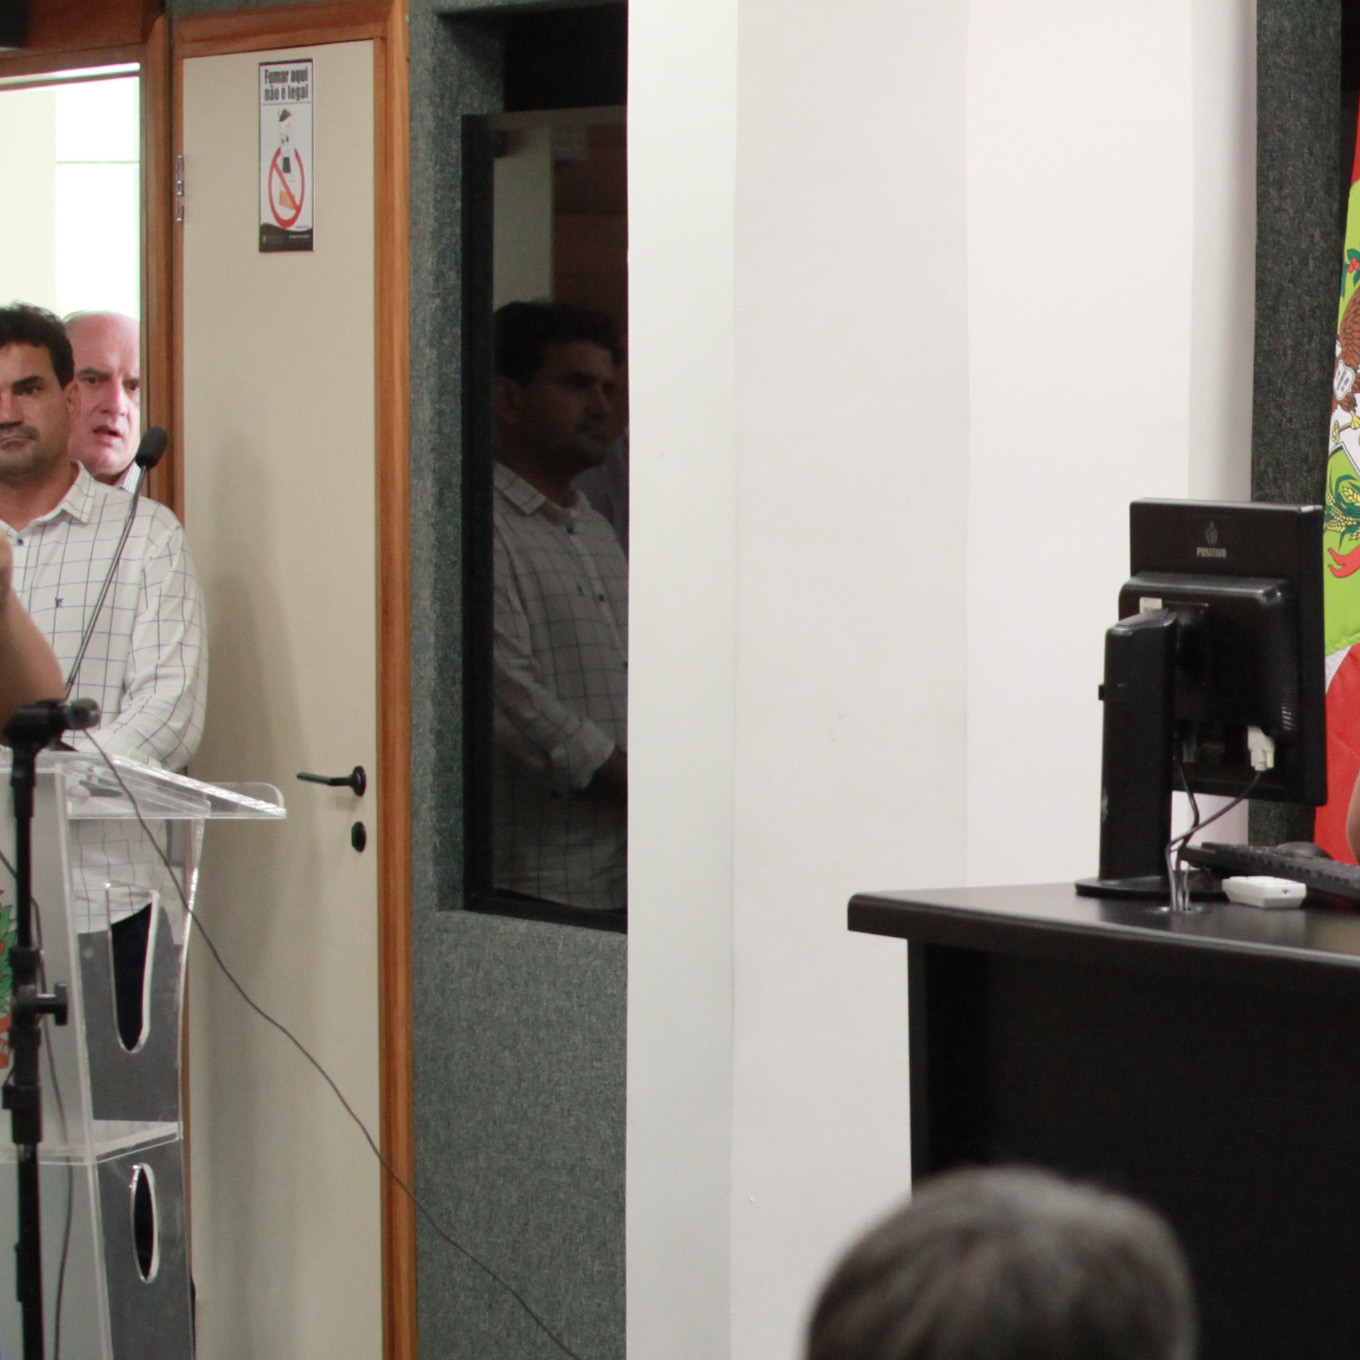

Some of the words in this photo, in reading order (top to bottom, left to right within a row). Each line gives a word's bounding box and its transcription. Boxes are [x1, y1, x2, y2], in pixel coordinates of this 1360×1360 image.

[264, 69, 289, 84] Fumar
[290, 66, 308, 84] aqui
[264, 85, 280, 101] não
[288, 84, 308, 101] legal
[1196, 546, 1227, 559] POSITIVO
